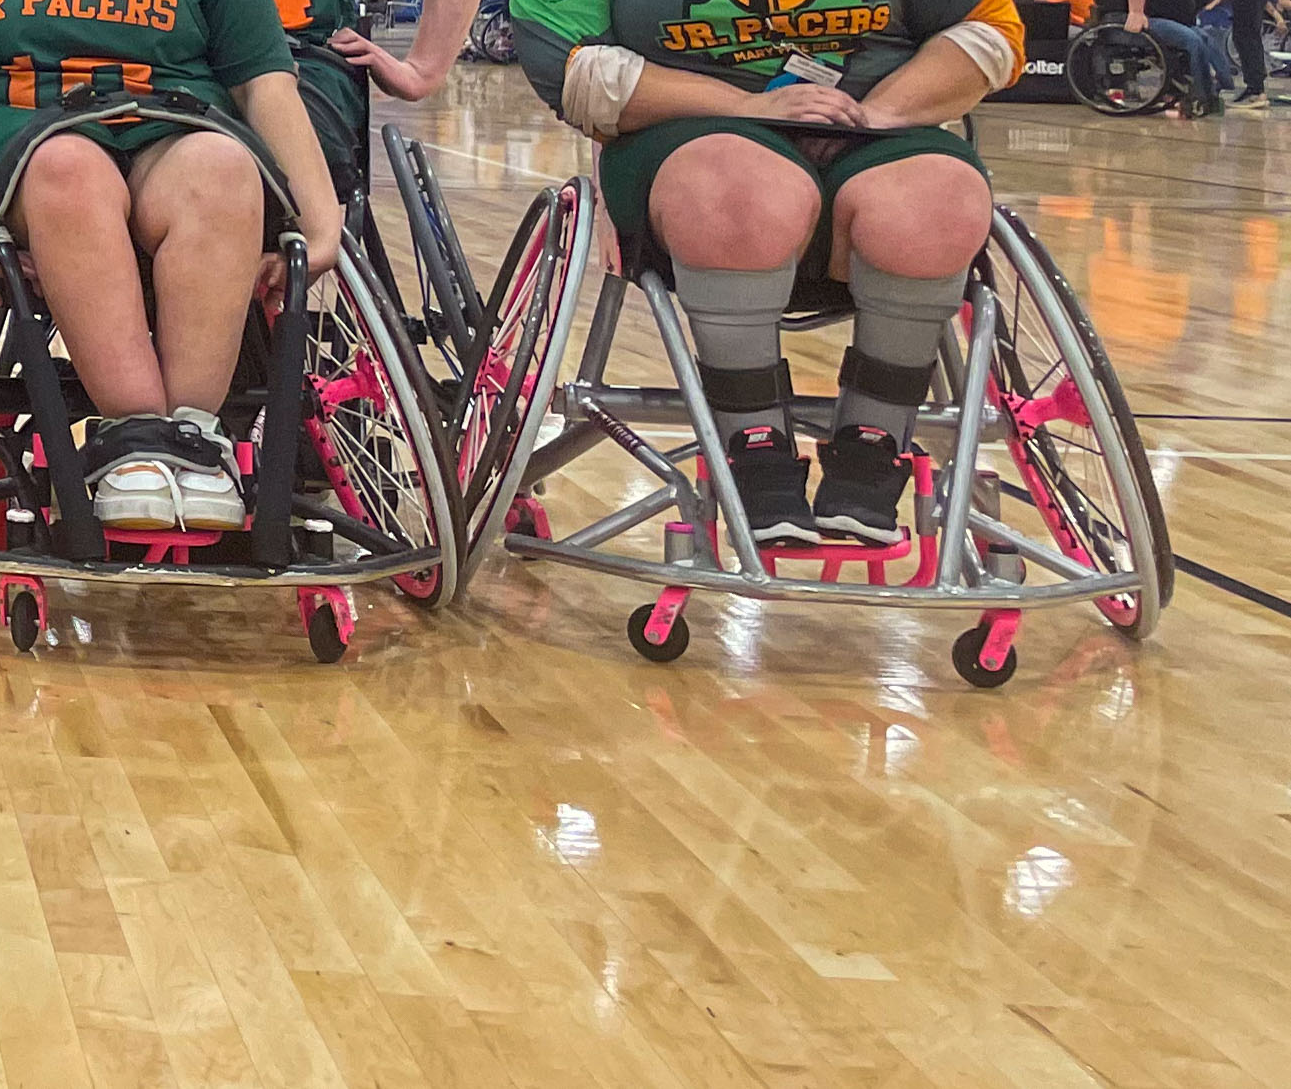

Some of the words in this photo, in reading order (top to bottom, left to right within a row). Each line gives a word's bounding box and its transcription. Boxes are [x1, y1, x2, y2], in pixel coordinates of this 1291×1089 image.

[662, 21, 729, 52] JR.
[734, 3, 892, 44] PACERS
[733, 46, 773, 64] MARY
